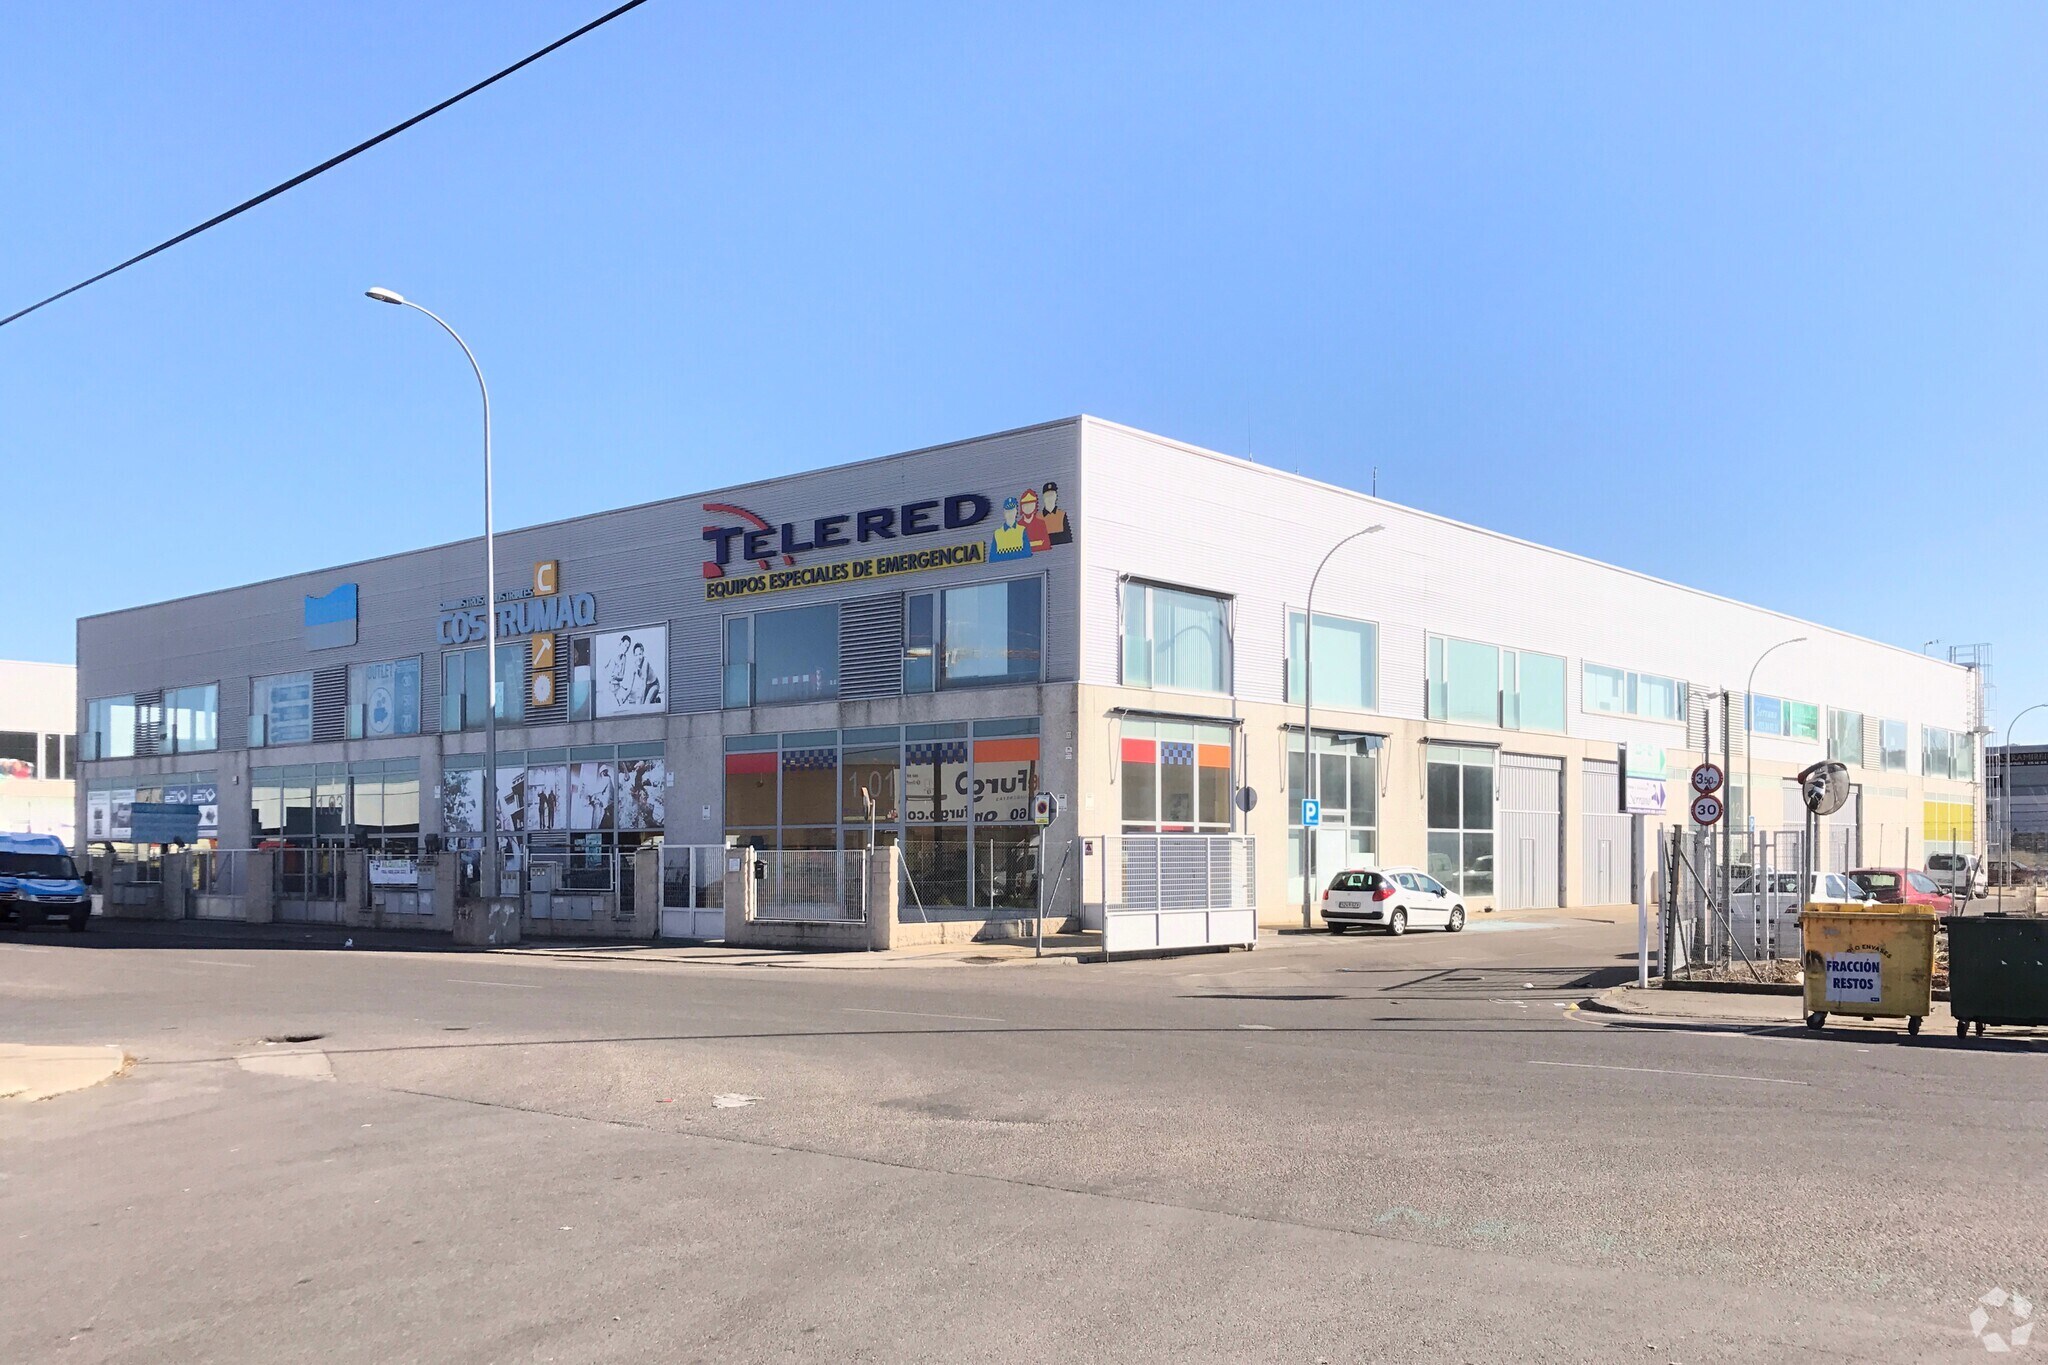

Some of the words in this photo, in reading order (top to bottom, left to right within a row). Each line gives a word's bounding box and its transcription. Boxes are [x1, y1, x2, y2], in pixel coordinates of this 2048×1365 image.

[703, 494, 991, 565] TELERED
[706, 576, 766, 598] EQUIPOS
[769, 563, 849, 590] ESPECIALES
[852, 560, 873, 577] DE
[876, 544, 981, 574] EMERGENCIA
[1305, 802, 1316, 823] P
[1697, 804, 1717, 815] 30
[1862, 944, 1892, 959] ENVASES
[1826, 958, 1880, 973] FRACCIÓN
[1833, 978, 1873, 990] RESTOS
